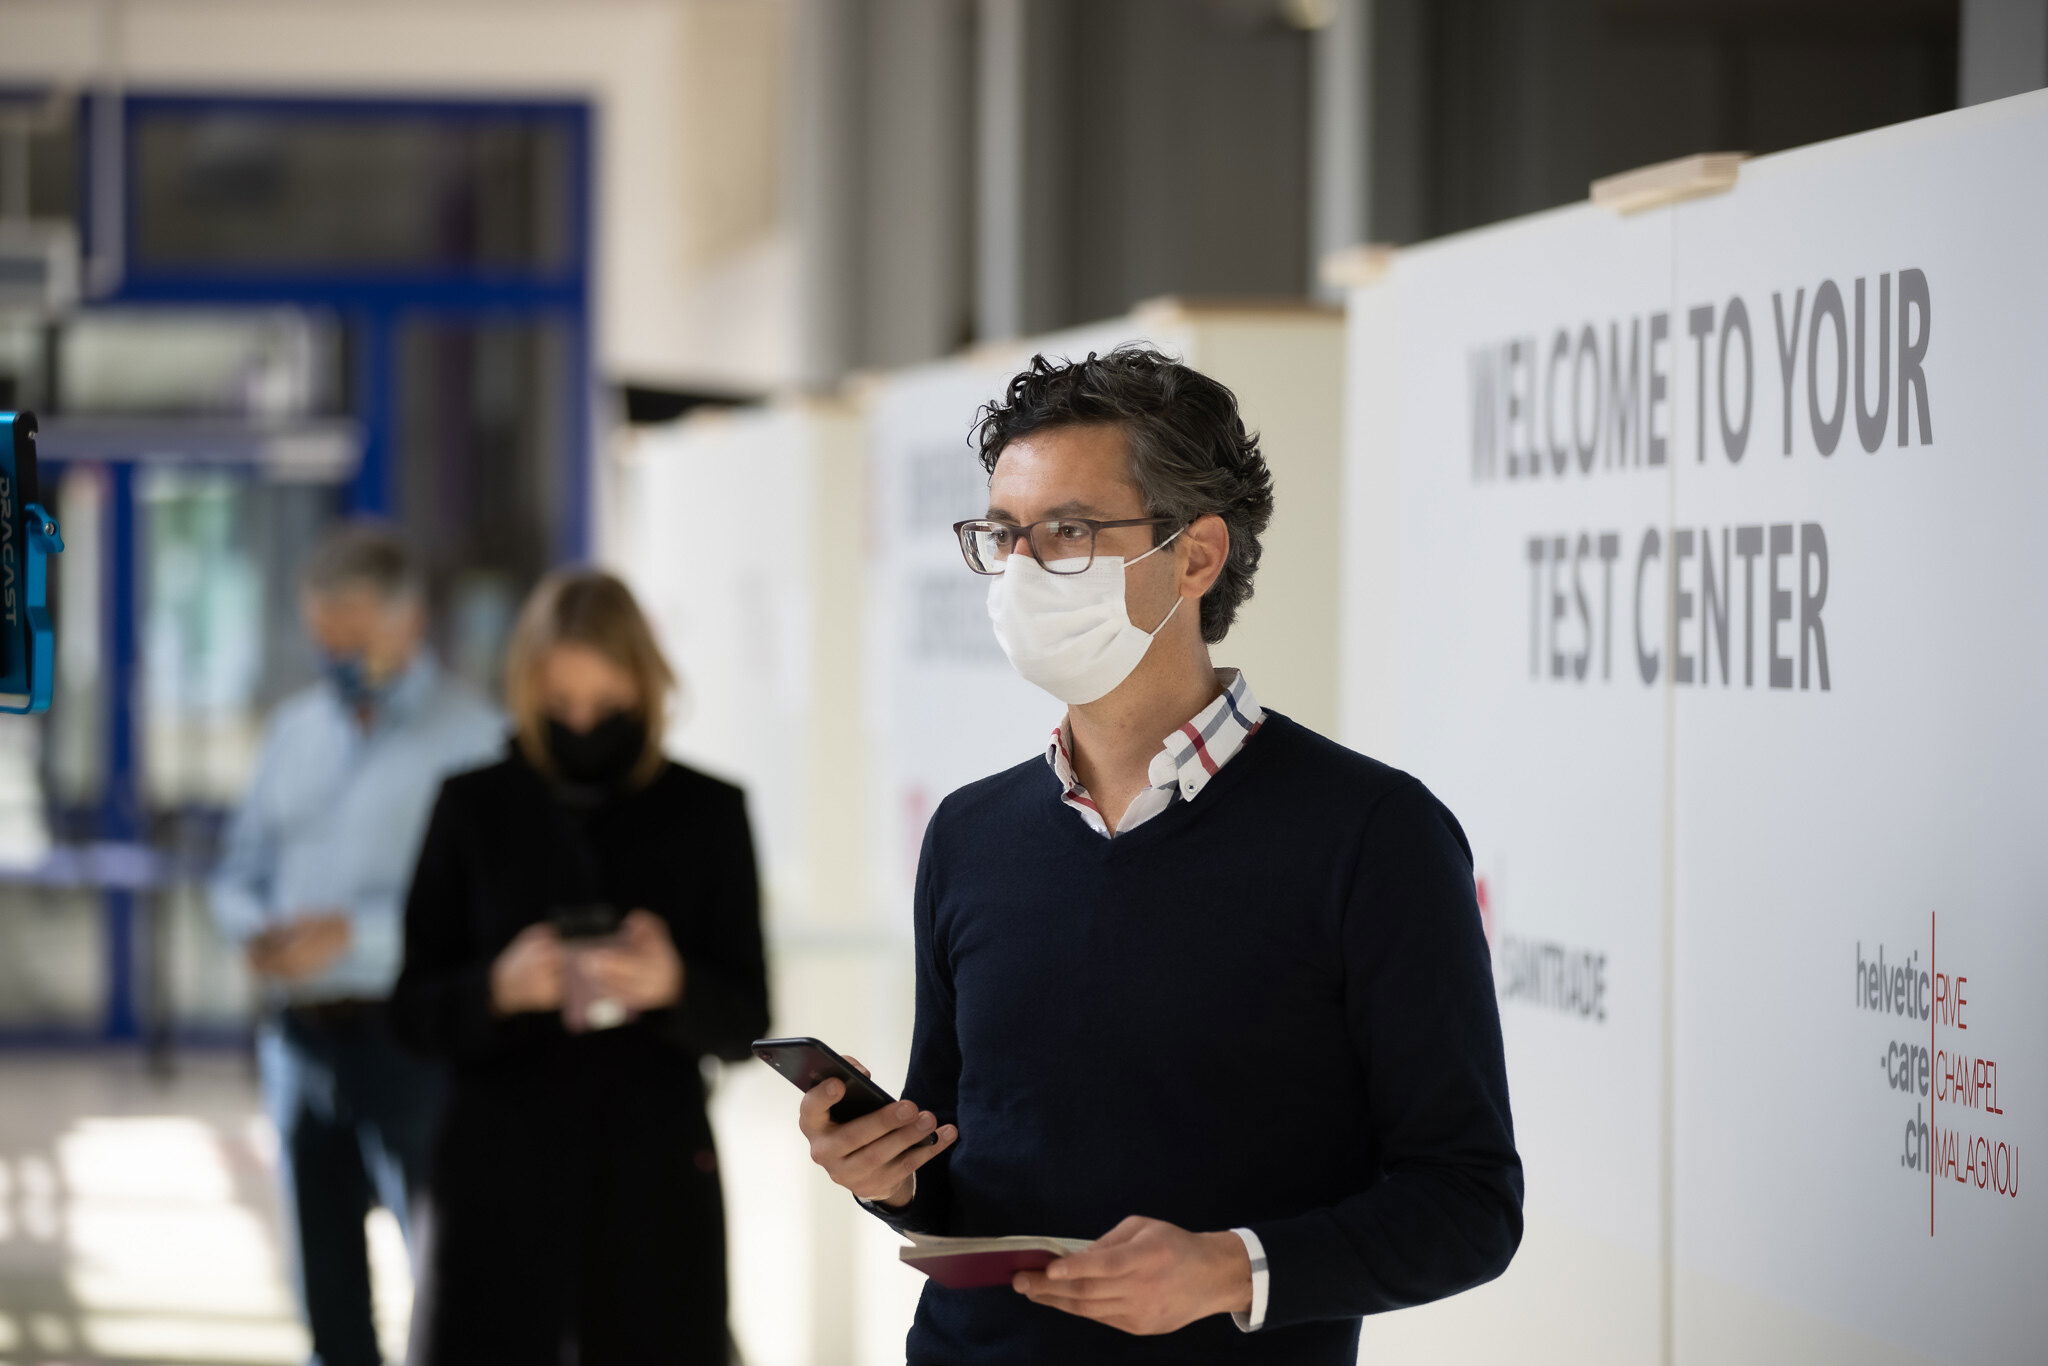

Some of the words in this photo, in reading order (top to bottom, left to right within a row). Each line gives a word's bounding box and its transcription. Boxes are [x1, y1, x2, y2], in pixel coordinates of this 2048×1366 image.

[1466, 310, 1669, 485] WELCOME
[1689, 295, 1753, 465] TO
[1772, 268, 1933, 458] YOUR
[0, 477, 17, 627] DRACAST
[1526, 531, 1620, 683] TEST
[1634, 522, 1831, 692] CENTER
[1856, 941, 1930, 1021] helvetic
[1935, 973, 1967, 1029] RIVE
[1935, 1050, 2003, 1115] CHAMPEL
[1901, 1102, 1930, 1174] .ch
[1935, 1126, 2019, 1198] MALAGNOU
